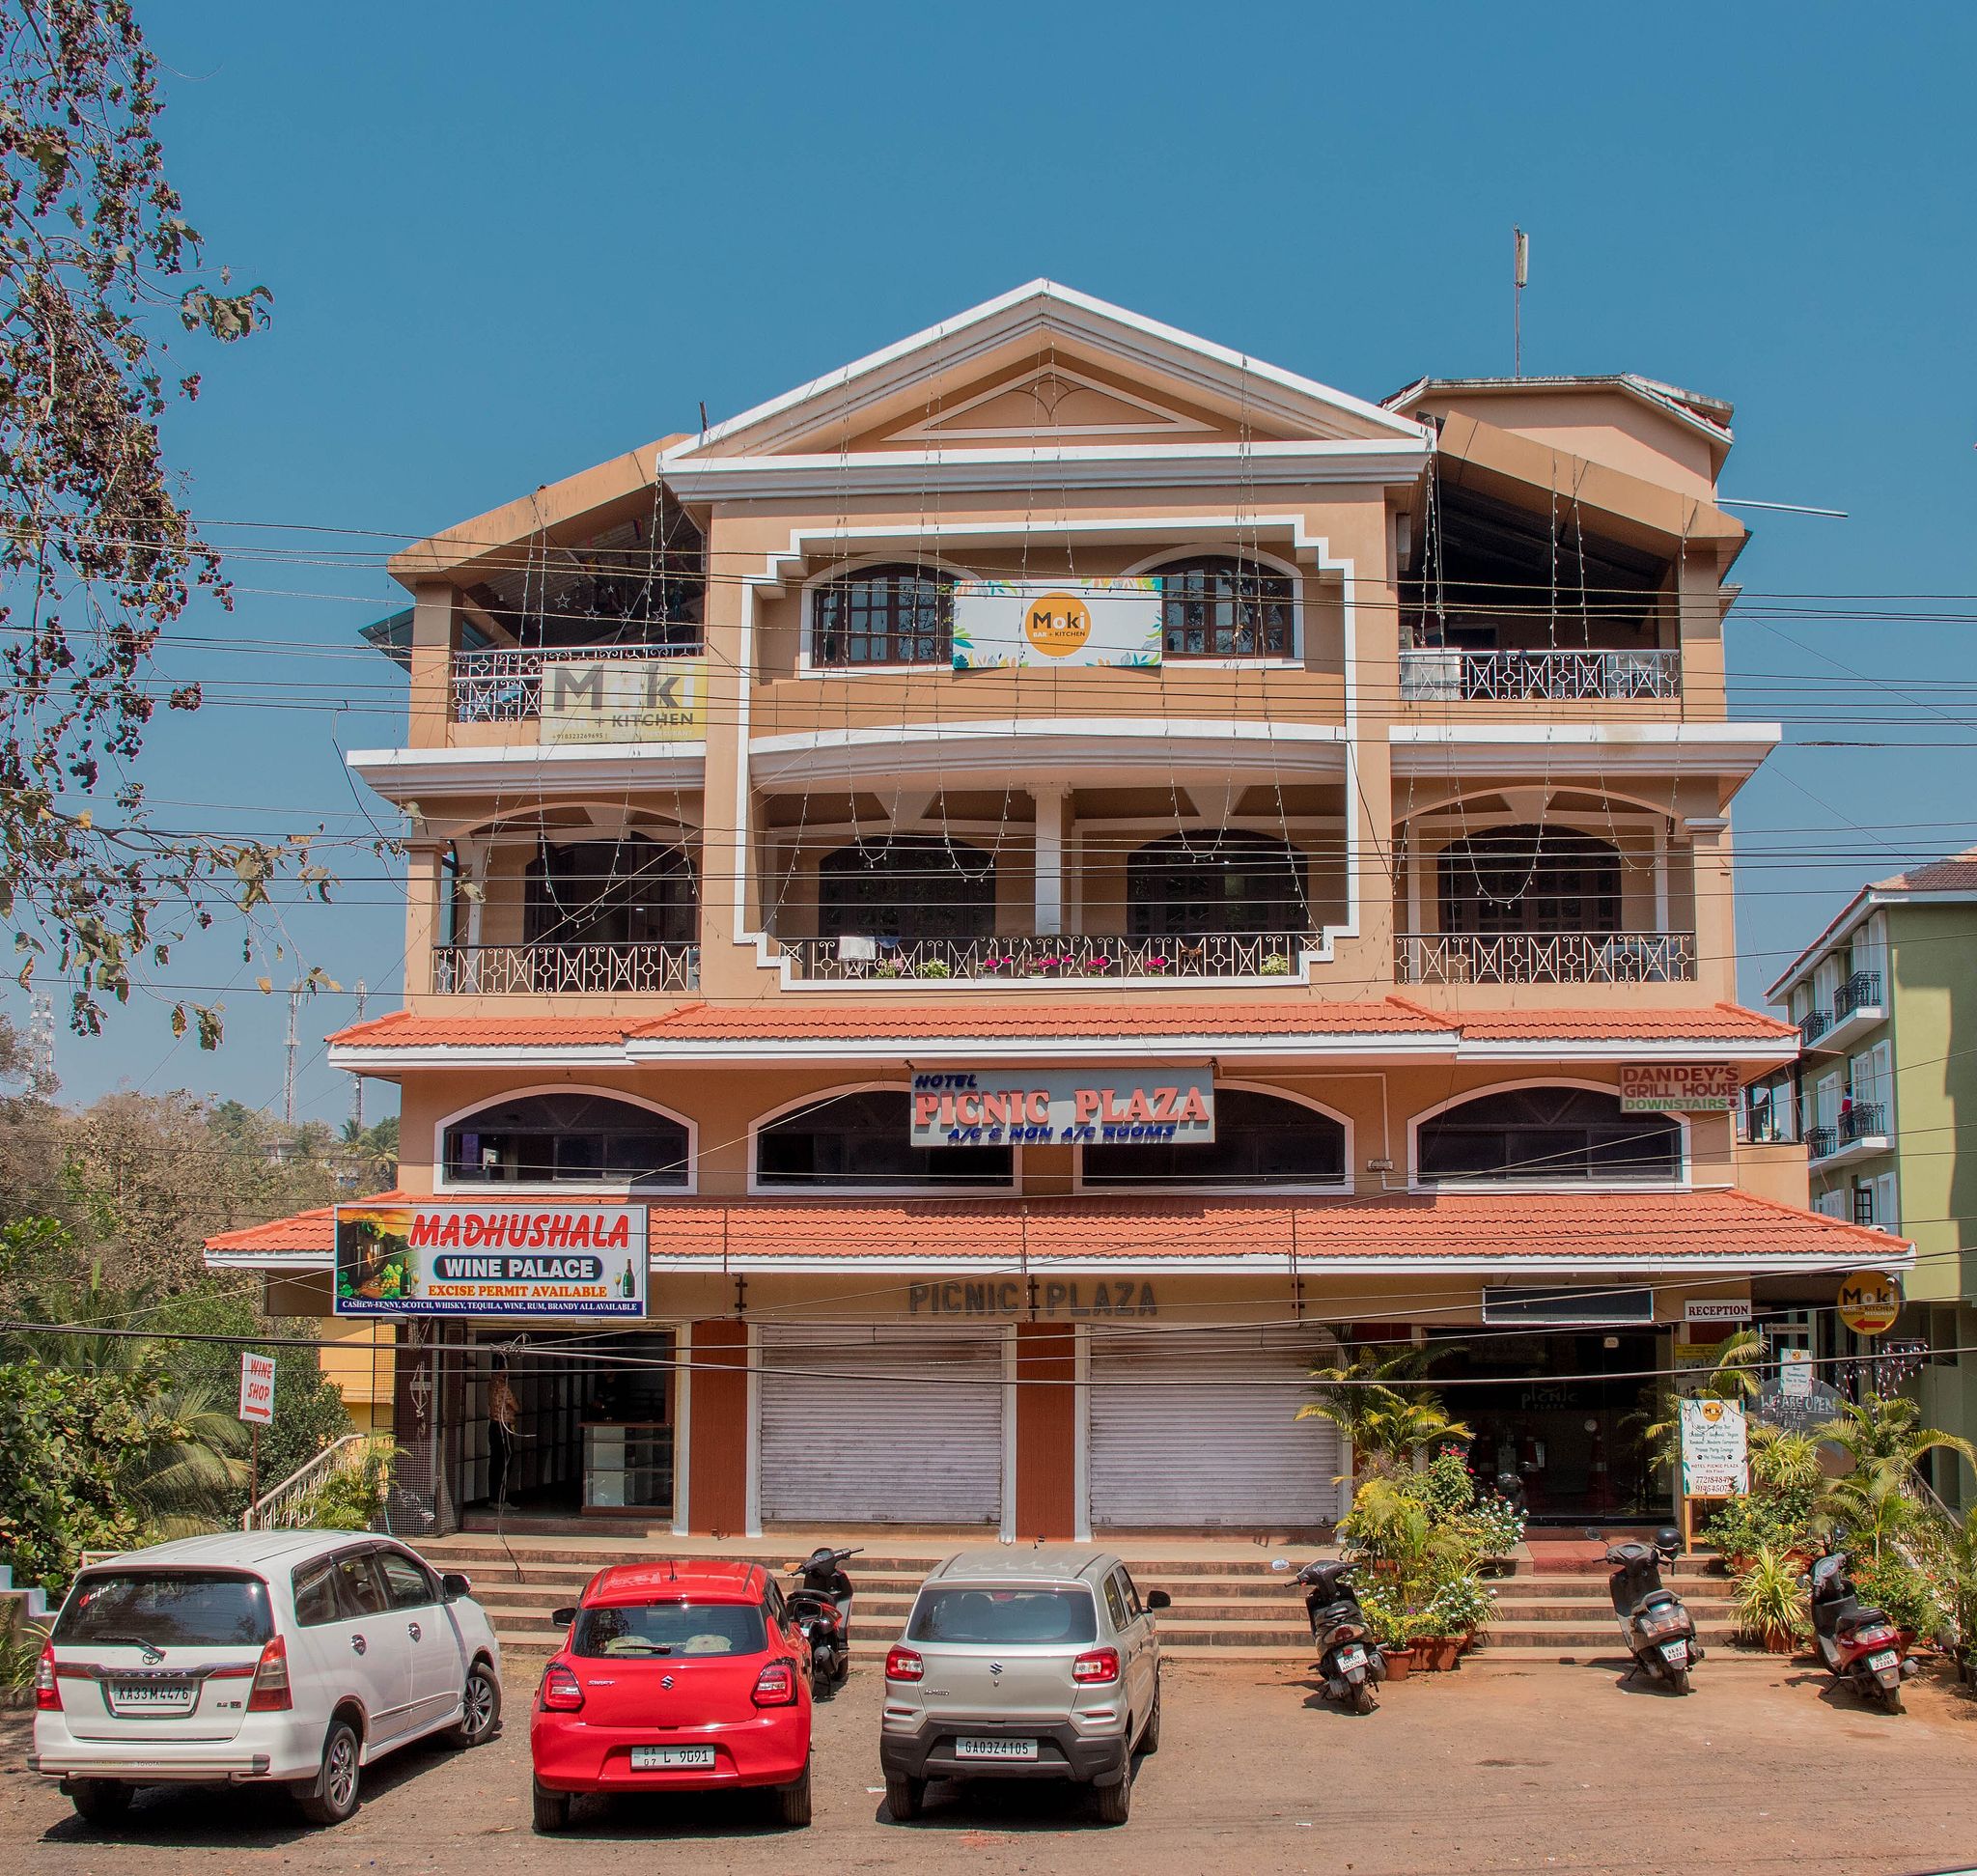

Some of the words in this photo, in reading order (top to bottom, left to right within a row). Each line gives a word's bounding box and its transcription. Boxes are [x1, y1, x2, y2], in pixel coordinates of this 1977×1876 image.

[1033, 611, 1085, 630] Moki
[612, 713, 694, 728] KITCHEN
[914, 1074, 978, 1089] HOTEL
[1623, 1067, 1739, 1082] DANDEY'S
[1624, 1083, 1675, 1098] GRILL
[1683, 1082, 1739, 1097] HOUSE
[914, 1089, 1050, 1125] PICNIC
[1073, 1086, 1211, 1124] PLAZA
[1625, 1099, 1726, 1109] DOWNSTAIRS
[947, 1127, 982, 1139] A/C
[1010, 1126, 1054, 1139] NON
[1060, 1126, 1097, 1138] A/C
[1102, 1125, 1177, 1137] ROOMS
[408, 1213, 630, 1248] MADHUSHALA
[444, 1259, 503, 1278] WINE
[508, 1259, 595, 1279] PALACE
[428, 1285, 475, 1297] EXCISE
[478, 1285, 529, 1297] PERMIT
[531, 1286, 607, 1298] AVAILABLE
[1843, 1286, 1895, 1304] Moki
[435, 1302, 466, 1310] WHISKY,
[467, 1302, 503, 1310] TEQUILA,
[547, 1302, 578, 1311] BRANDY
[909, 1282, 1018, 1316] PICNIC
[1046, 1282, 1157, 1317] PLAZA
[1687, 1305, 1748, 1316] RECEPTION
[251, 1358, 273, 1379] WINE
[248, 1383, 270, 1402] SHOP
[1782, 1396, 1803, 1409] ARE
[1805, 1396, 1836, 1412] OPEN
[119, 1687, 188, 1699] KA33M4476
[965, 1741, 1028, 1754] GA03Z4105
[664, 1750, 671, 1763] L
[680, 1750, 709, 1763] 9091
